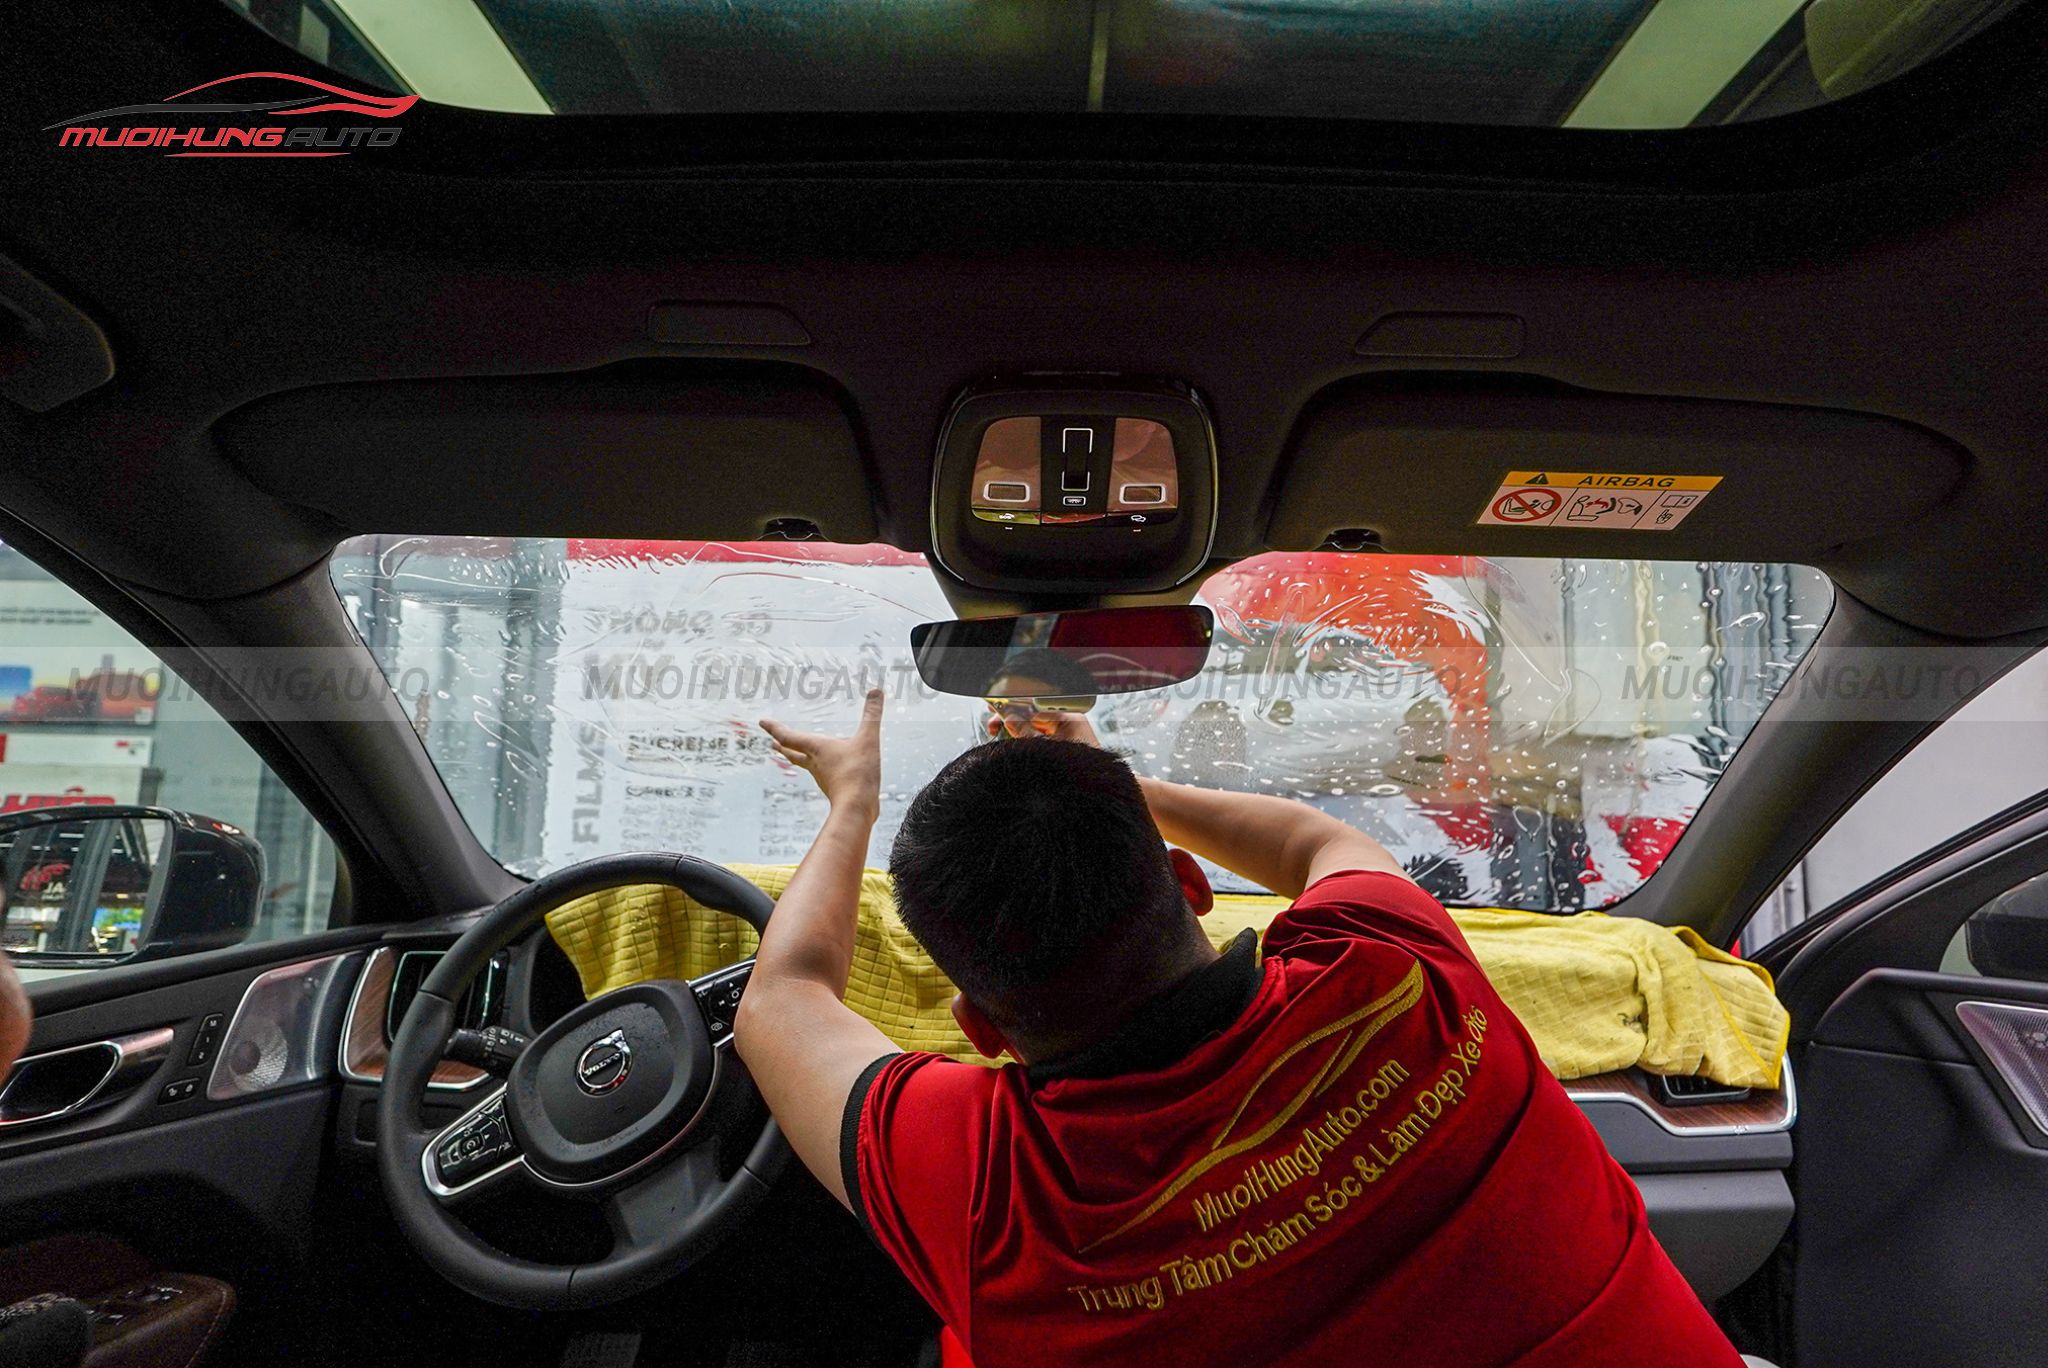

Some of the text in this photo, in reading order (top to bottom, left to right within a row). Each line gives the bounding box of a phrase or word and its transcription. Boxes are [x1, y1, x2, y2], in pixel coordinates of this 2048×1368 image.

[1577, 475, 1676, 488] AIRBAG
[1450, 1041, 1482, 1077] Xe
[1368, 1112, 1431, 1166] Làm
[1352, 1155, 1386, 1183] &
[1305, 1175, 1363, 1222] Sóc
[1229, 1211, 1317, 1269] Chăm
[1067, 1276, 1165, 1311] Trung
[1159, 1254, 1233, 1297] Tâm
